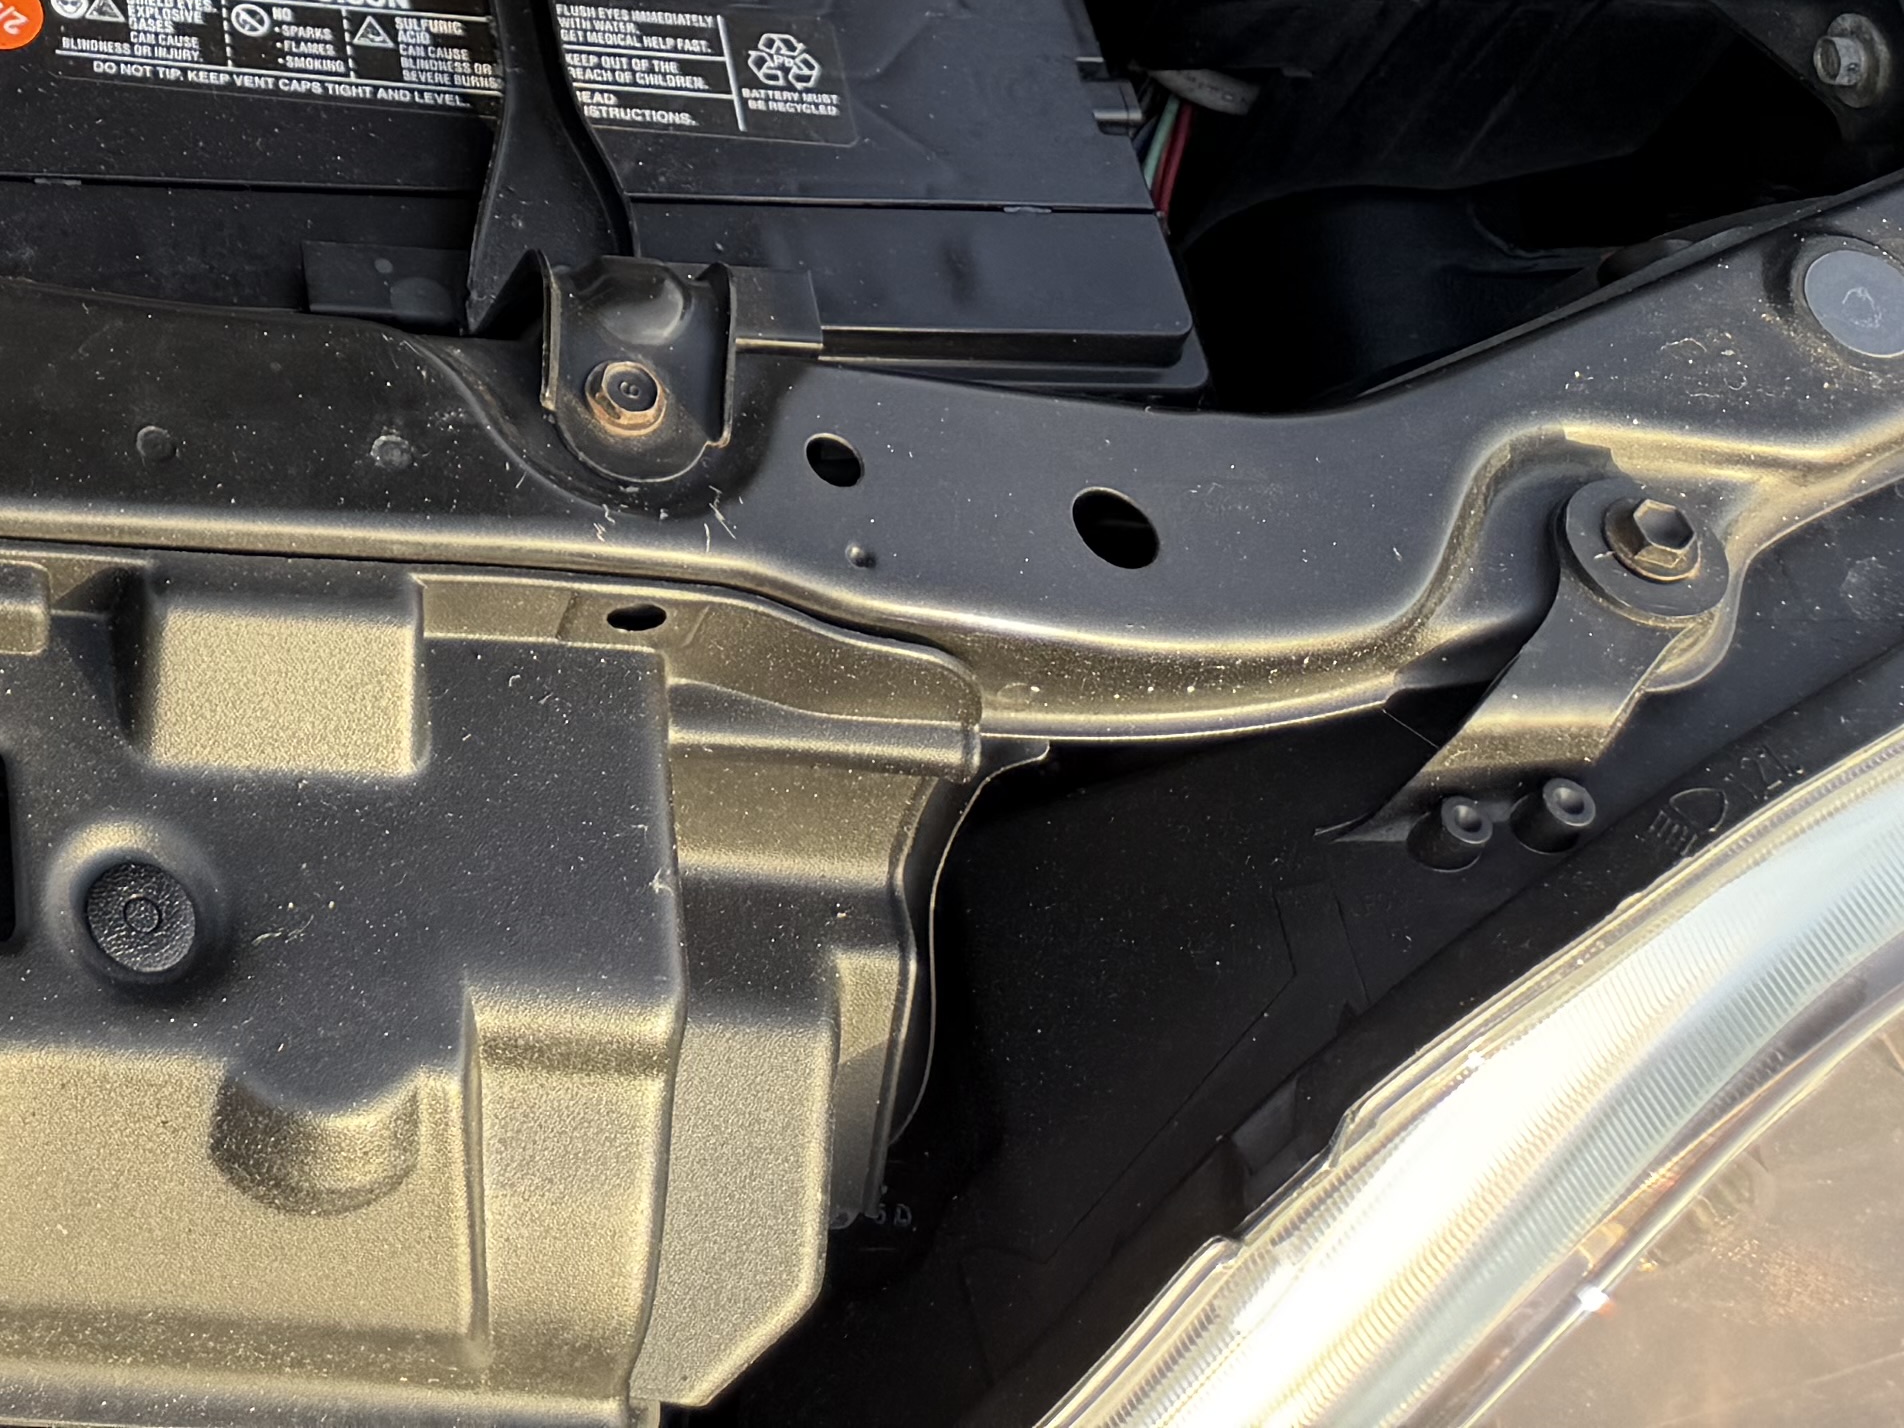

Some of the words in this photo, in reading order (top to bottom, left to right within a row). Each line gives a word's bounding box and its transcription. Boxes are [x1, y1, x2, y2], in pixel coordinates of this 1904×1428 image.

[127, 5, 204, 24] EXPLOSIVE
[272, 7, 292, 21] NO
[556, 4, 596, 18] FLUSH
[598, 7, 629, 21] EYES
[631, 10, 714, 28] IMMEDIATELY
[129, 18, 175, 33] GASES
[395, 16, 464, 35] SULFURIC
[558, 18, 591, 30] WITH
[593, 20, 641, 34] WATER.
[131, 31, 155, 45] CAN
[159, 33, 200, 48] CAUSE
[282, 27, 333, 42] SPARKS
[398, 31, 431, 44] ACID
[560, 29, 583, 42] GET
[585, 31, 641, 48] MEDICAL
[643, 36, 674, 51] HELP
[676, 39, 712, 53] FAST.
[62, 37, 132, 55] BLINDNESS
[134, 43, 152, 57] OR
[154, 46, 203, 62] INJURY.
[283, 40, 336, 56] FLAMES
[399, 45, 425, 58] CAN
[428, 46, 469, 61] CAUSE
[285, 56, 345, 72] SMOKING
[400, 57, 472, 74] BLINDNESS
[474, 63, 492, 76] OR
[565, 54, 599, 66] KEEP
[601, 56, 629, 69] OUT
[631, 59, 649, 72] OF
[652, 61, 679, 73] THE
[93, 61, 116, 74] DO
[121, 63, 152, 77] NOT
[157, 66, 183, 80] TIP.
[188, 69, 230, 85] KEEP
[234, 75, 276, 91] VENT
[279, 78, 323, 94] CAPS
[326, 83, 373, 99] TIGHT
[377, 87, 410, 102] AND
[414, 91, 471, 108] LEVEL.
[403, 70, 451, 85] SEVERE
[615, 70, 633, 83] OF
[635, 72, 709, 89] CHILDREN.
[742, 88, 800, 102] BATTERY
[803, 93, 840, 105] MUST
[748, 100, 766, 111] BE
